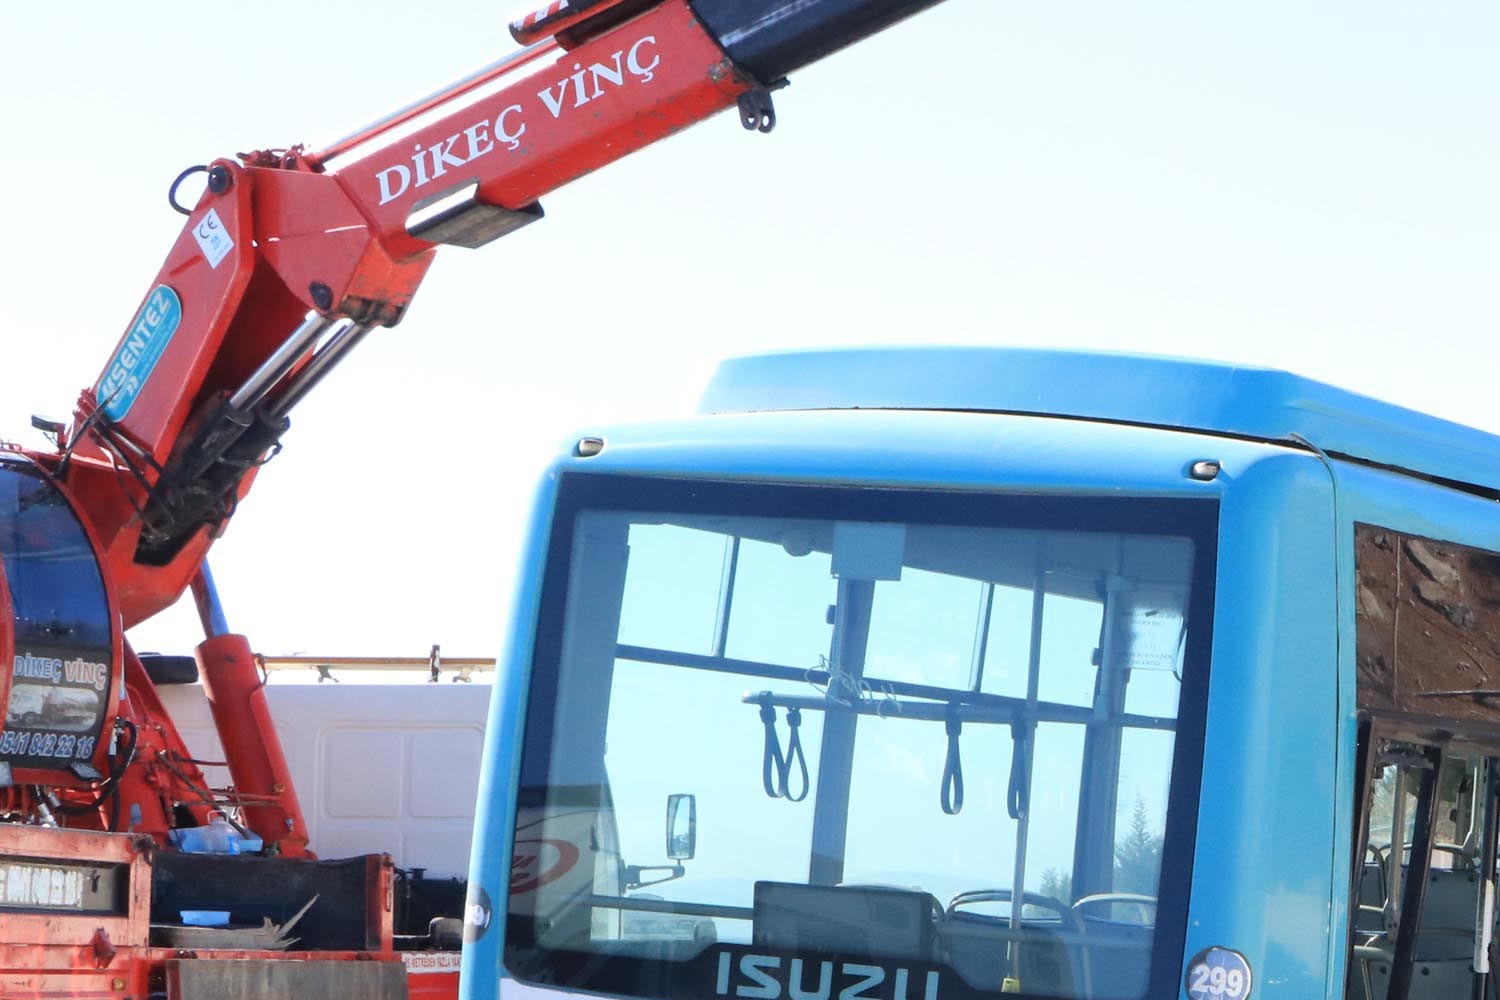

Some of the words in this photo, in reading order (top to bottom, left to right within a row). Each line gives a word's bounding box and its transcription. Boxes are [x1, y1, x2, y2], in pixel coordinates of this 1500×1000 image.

[375, 104, 526, 206] DİKEÇ
[537, 36, 660, 118] VİNÇ
[13, 652, 62, 683] DİKEÇ
[64, 657, 107, 691] VİNÇ
[28, 732, 57, 756] 842
[54, 734, 76, 758] 22
[75, 736, 95, 759] 16
[1190, 963, 1243, 998] 299
